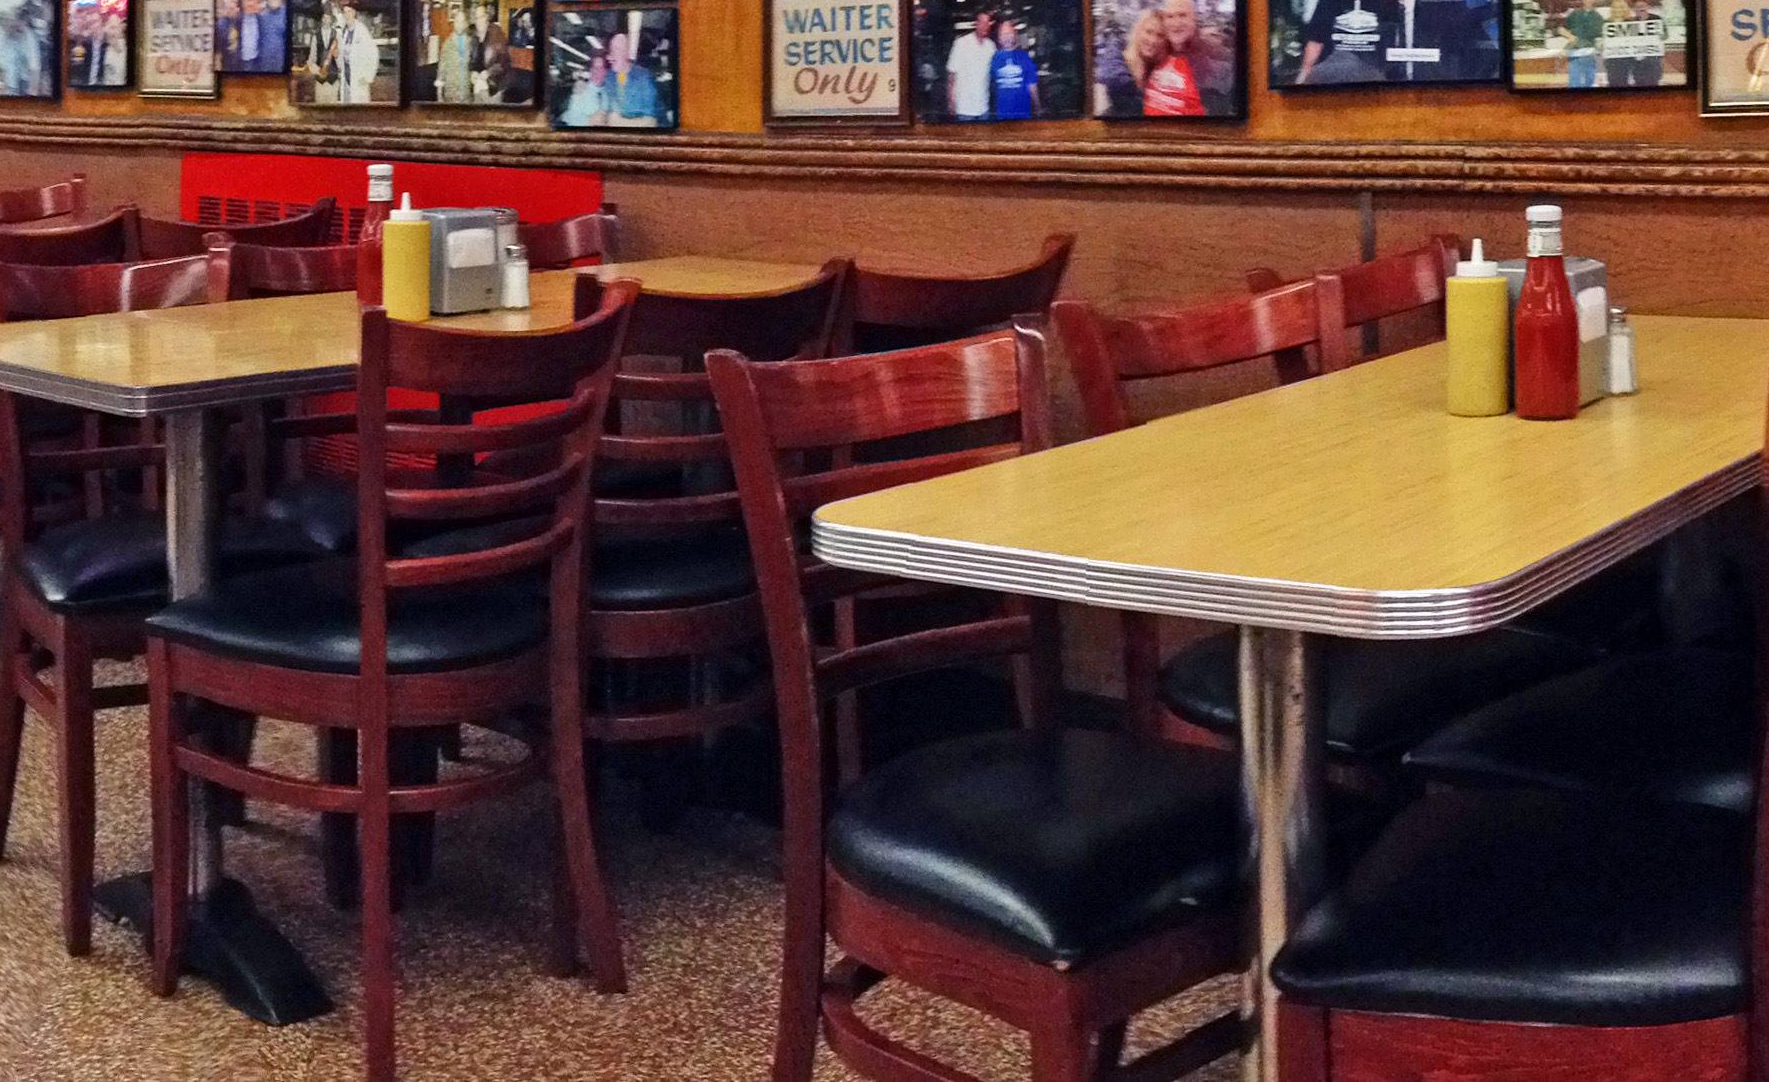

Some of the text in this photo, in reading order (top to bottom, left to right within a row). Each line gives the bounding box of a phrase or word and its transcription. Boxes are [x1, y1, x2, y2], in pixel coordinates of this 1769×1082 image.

[152, 9, 209, 29] WAITER
[783, 4, 894, 34] WAITER
[152, 34, 209, 52] SERVICE
[785, 37, 894, 66] SERVICE
[155, 56, 201, 82] Only
[794, 66, 878, 105] Only
